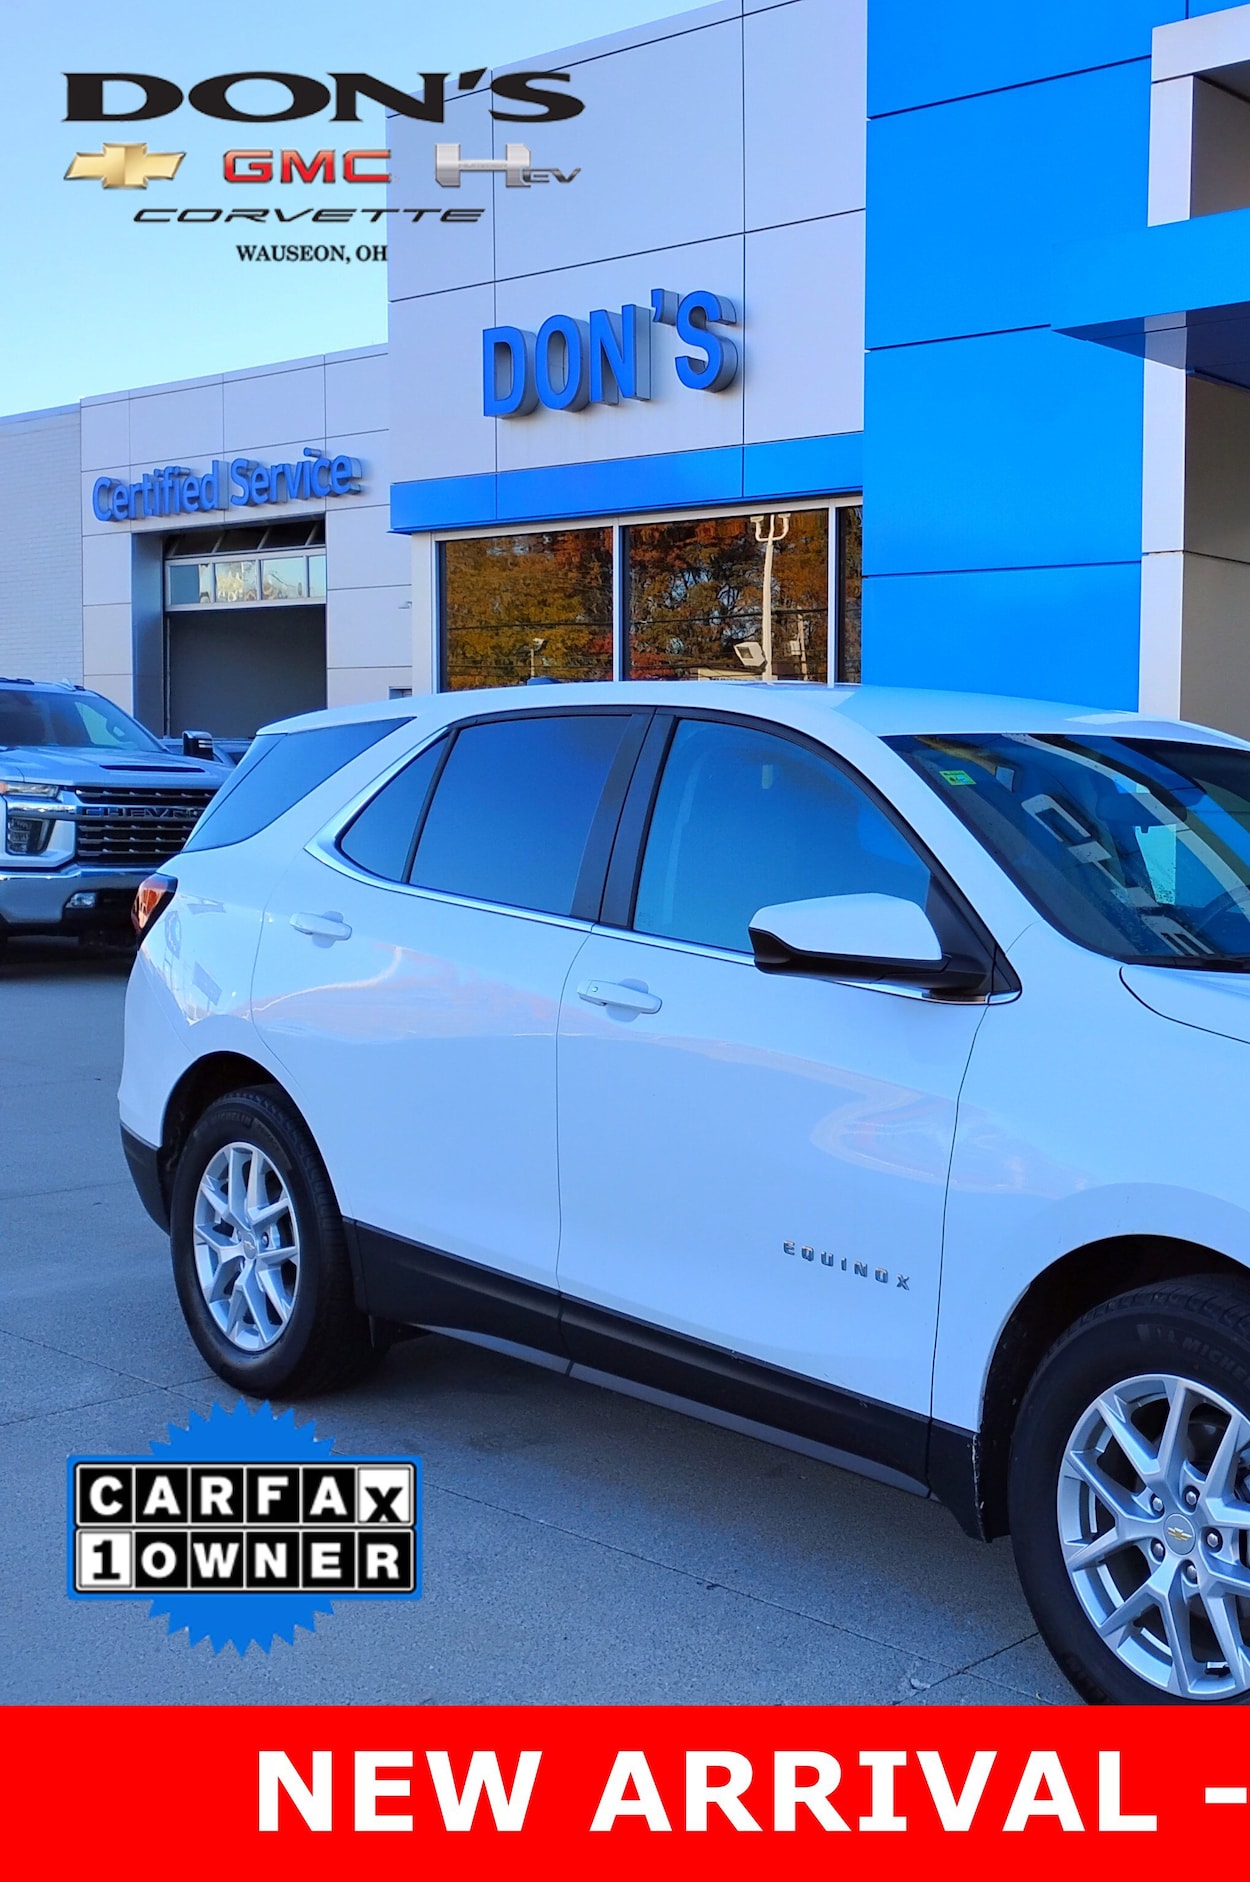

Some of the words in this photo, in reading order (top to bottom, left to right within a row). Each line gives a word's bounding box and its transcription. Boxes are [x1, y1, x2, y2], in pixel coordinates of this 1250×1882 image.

[482, 288, 743, 418] DON'S
[92, 466, 230, 522] Certified
[230, 447, 362, 506] Service
[783, 1240, 910, 1290] EQUINOX
